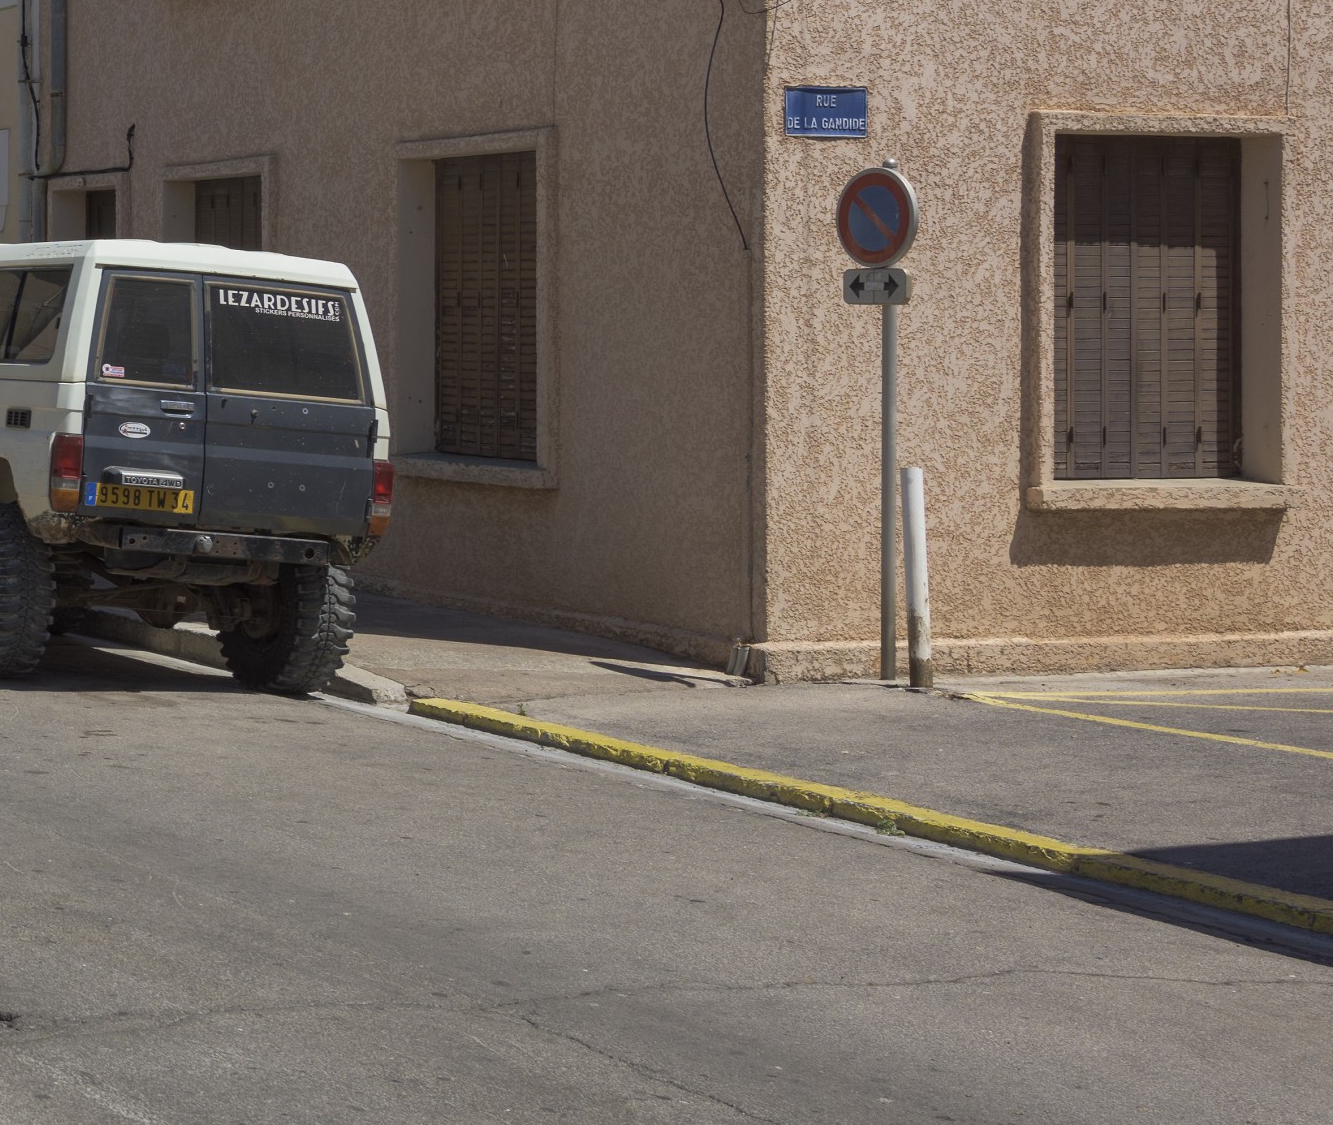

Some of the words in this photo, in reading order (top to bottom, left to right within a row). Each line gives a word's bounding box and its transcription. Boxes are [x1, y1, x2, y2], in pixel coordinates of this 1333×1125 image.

[816, 95, 837, 107] RUE
[787, 116, 800, 129] DE
[804, 117, 818, 129] LA
[821, 117, 866, 130] GANDIDE
[219, 289, 335, 316] LEZARDESIFS
[255, 307, 287, 317] STICKERS
[125, 476, 159, 486] TOYOTA
[161, 479, 182, 488] 4WD
[99, 486, 141, 506] 9598
[147, 490, 167, 508] TW
[171, 492, 188, 511] 34
